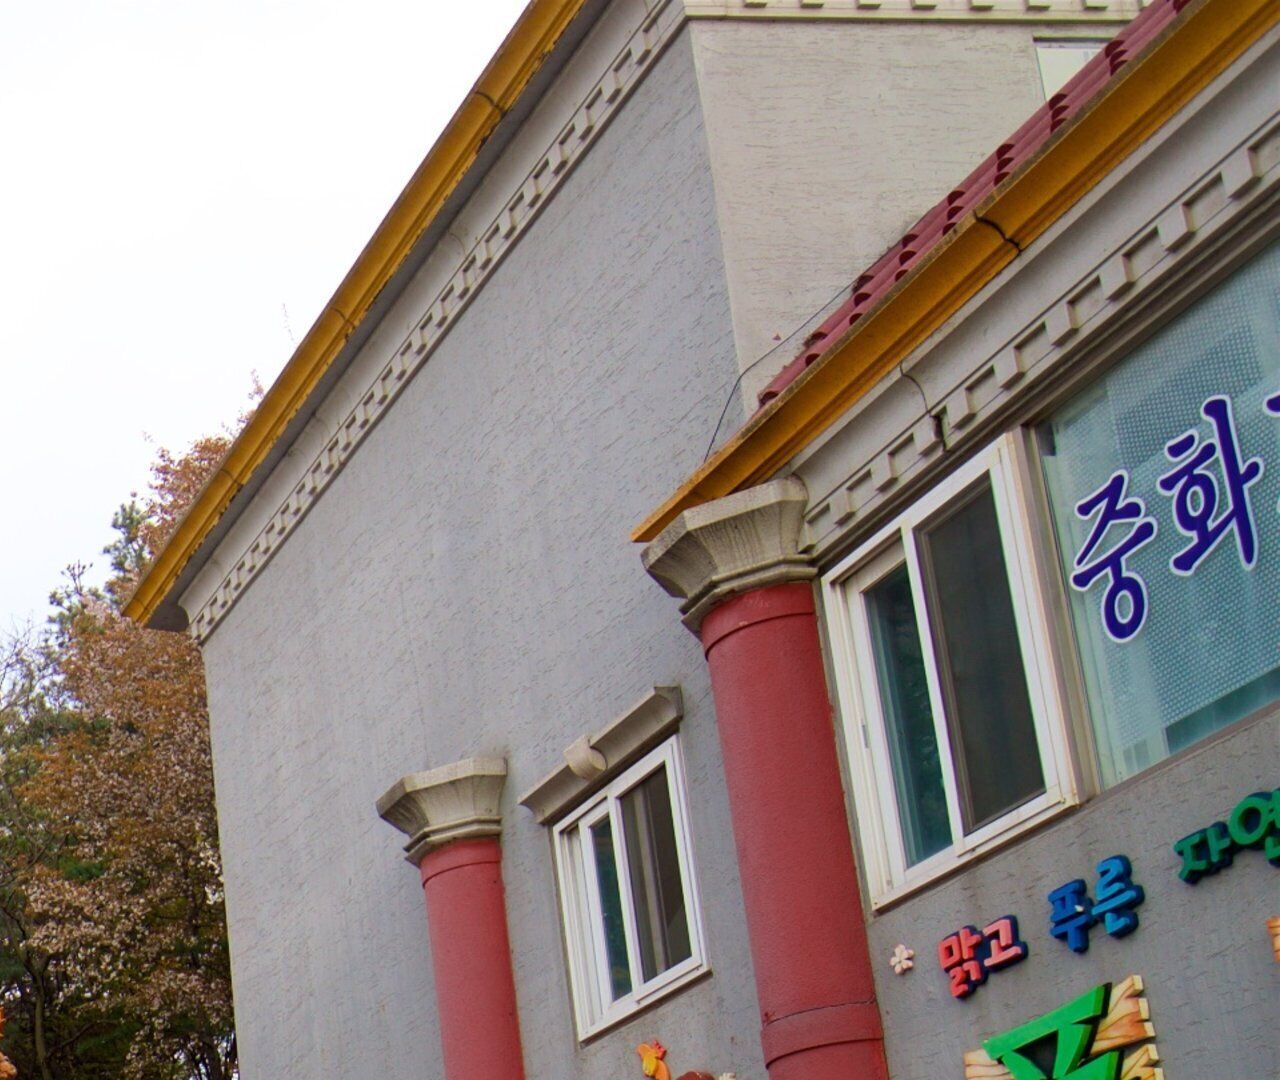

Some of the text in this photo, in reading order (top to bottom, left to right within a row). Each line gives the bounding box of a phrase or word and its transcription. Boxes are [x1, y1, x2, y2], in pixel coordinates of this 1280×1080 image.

[1072, 394, 1280, 643] 중화
[939, 914, 1028, 998] 맑고
[1048, 854, 1145, 953] 푸른
